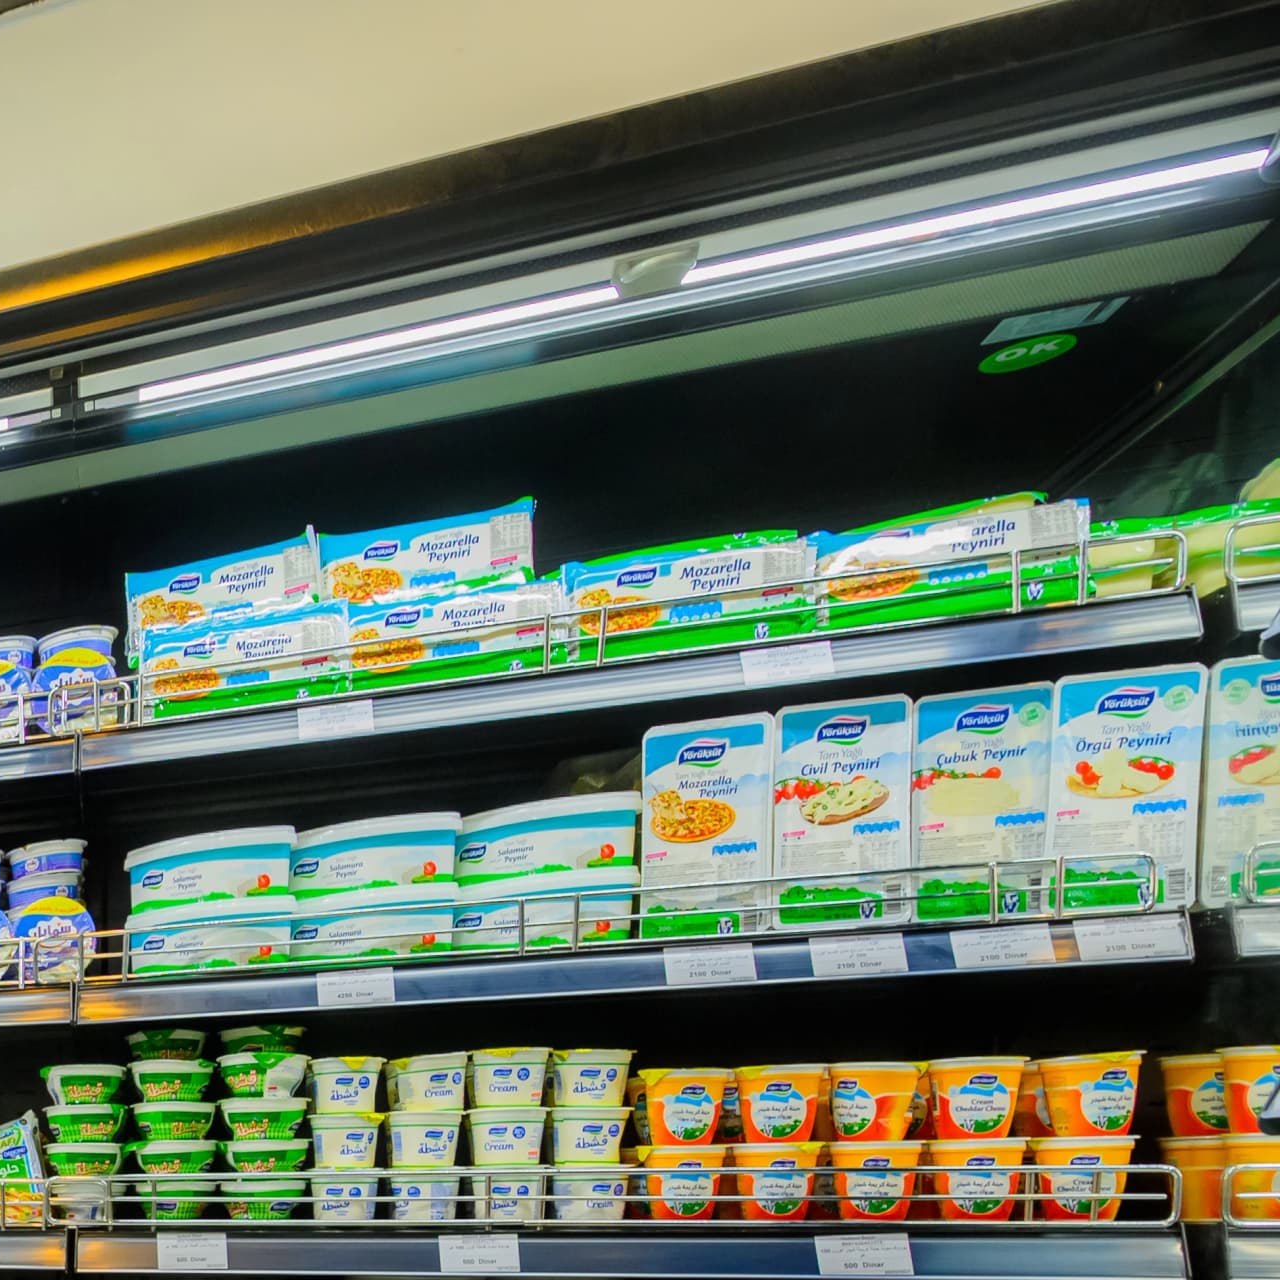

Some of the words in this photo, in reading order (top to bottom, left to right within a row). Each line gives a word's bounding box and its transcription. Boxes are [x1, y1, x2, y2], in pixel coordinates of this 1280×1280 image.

[996, 337, 1065, 362] OK
[418, 534, 480, 553] Mozarella
[428, 546, 471, 563] Peyniri
[219, 565, 274, 586] Mozarella
[679, 558, 751, 581] Mozarella
[228, 578, 266, 594] Peyniri
[690, 574, 741, 591] Peyniri
[442, 602, 505, 621] Mozarella
[1103, 696, 1151, 710] Yörüksüt
[961, 713, 1006, 728] Yörüksüt
[822, 724, 863, 738] Yörüksüt
[1076, 736, 1112, 753] Örgü
[1119, 732, 1171, 750] Peyniri
[683, 749, 722, 760] Yörüksüt
[937, 751, 977, 767] Çubuk
[984, 746, 1026, 761] Peynir
[801, 765, 828, 776] Civil
[832, 757, 880, 775] Peyniri
[678, 776, 732, 790] Mozarella
[700, 785, 737, 798] Peyniri
[1004, 952, 1027, 960] Dinar
[330, 1087, 359, 1101] قشطة
[425, 1087, 454, 1097] Cream
[489, 1083, 518, 1093] Cream
[573, 1080, 607, 1094] قشطة
[484, 1142, 514, 1150] Cream
[575, 1135, 609, 1149] قشطة
